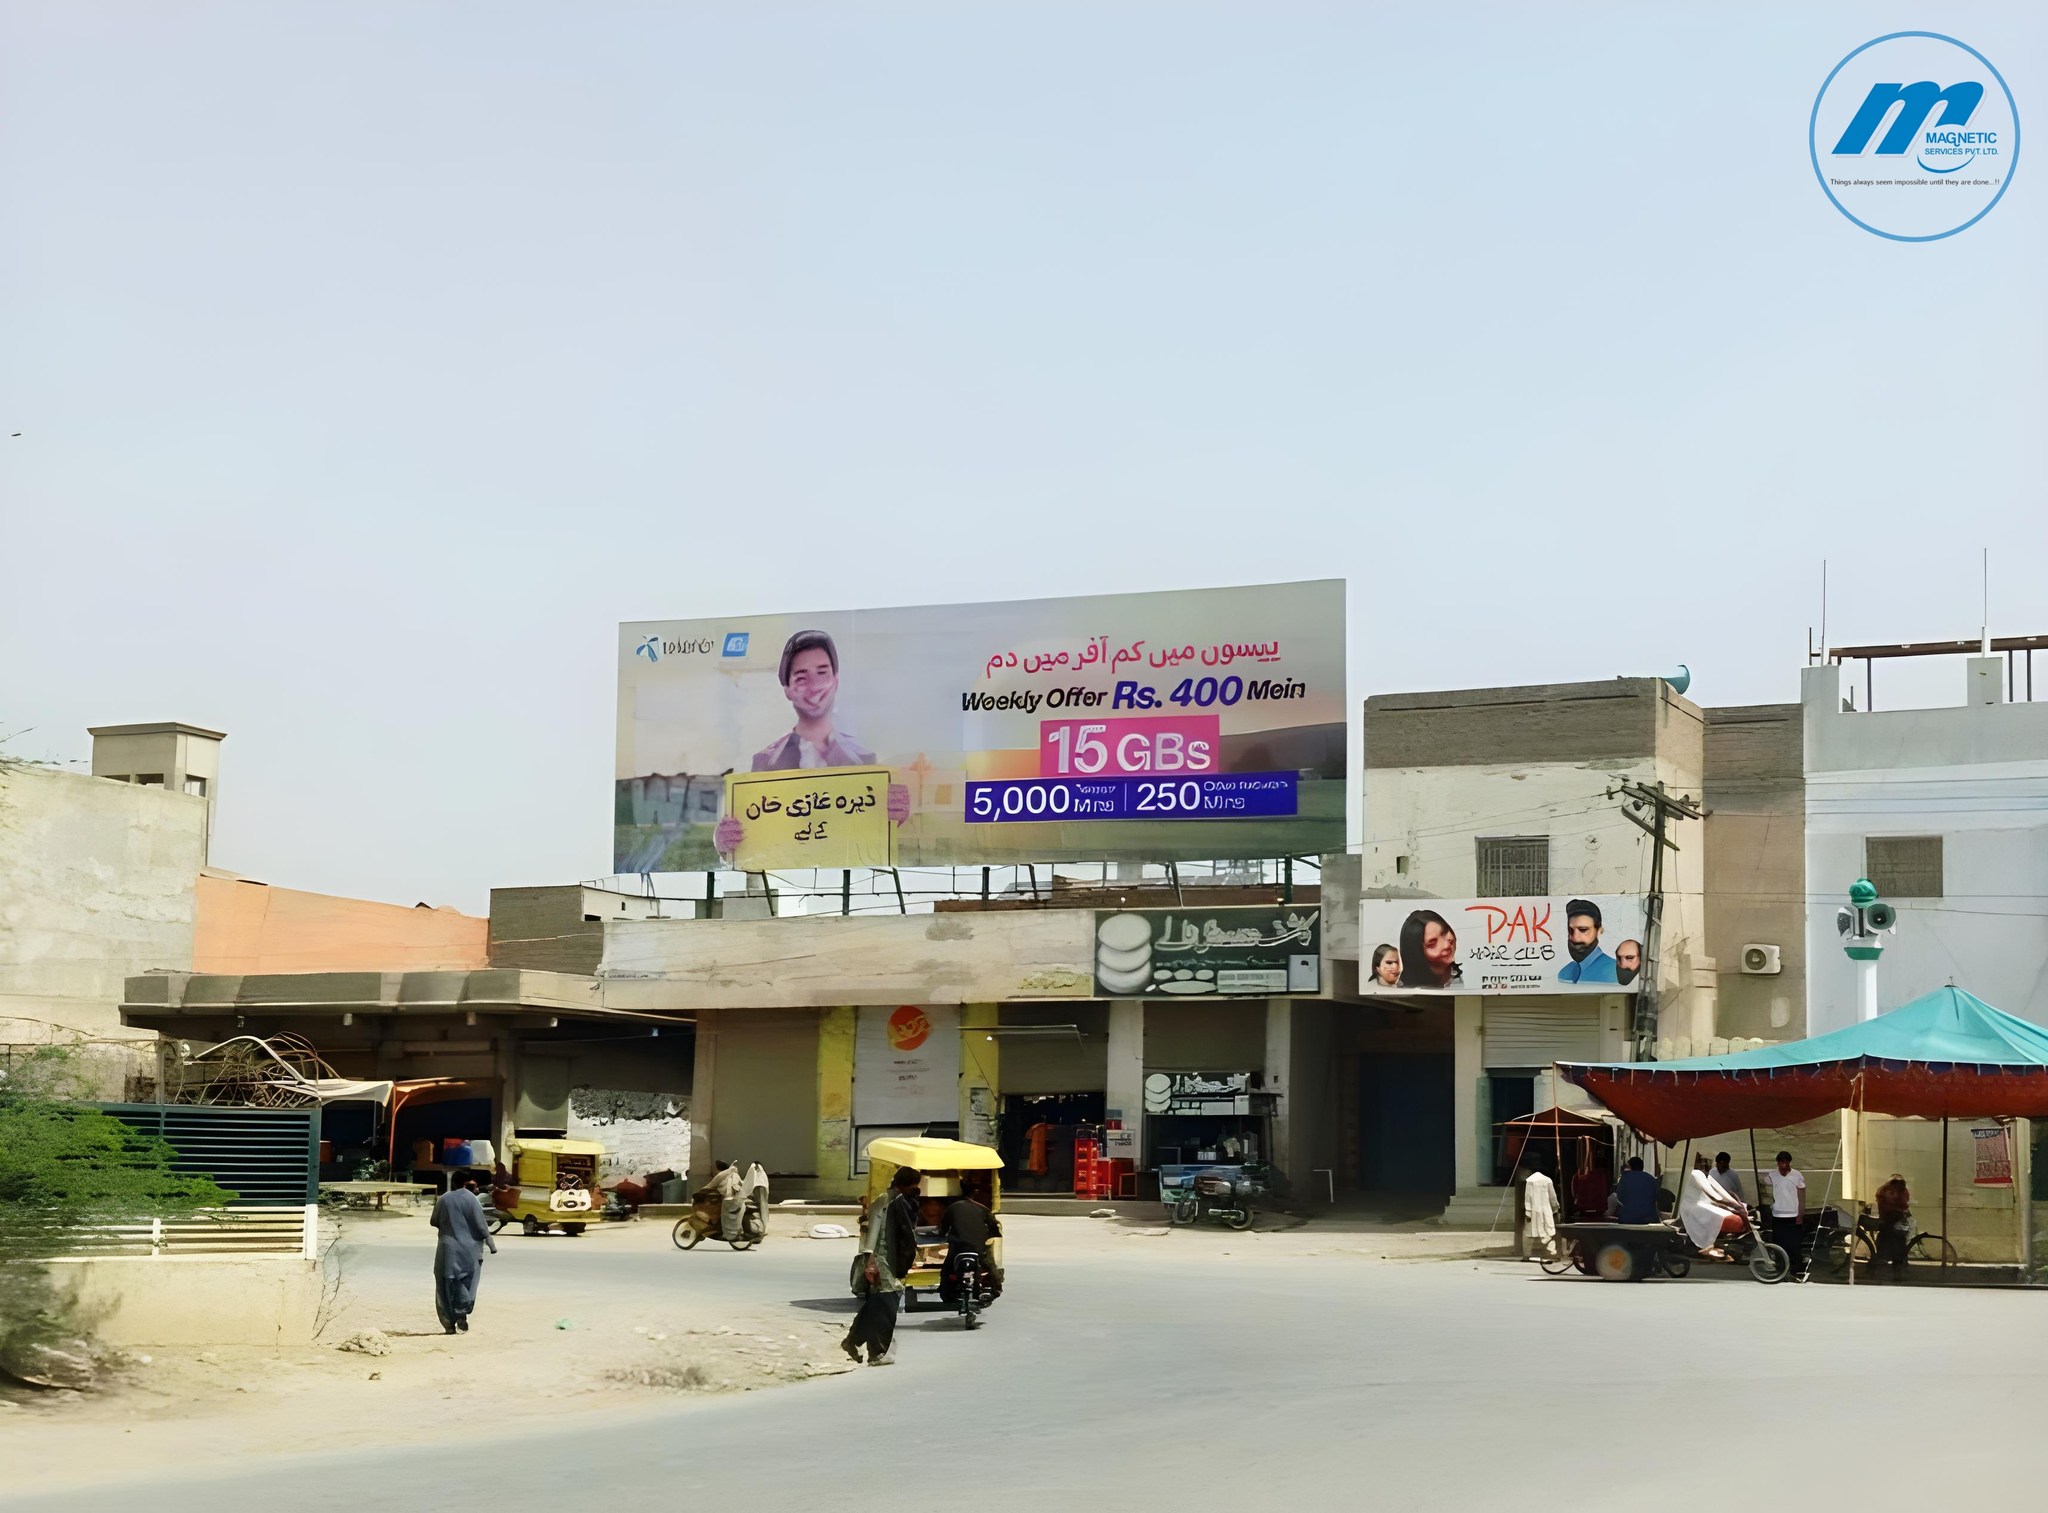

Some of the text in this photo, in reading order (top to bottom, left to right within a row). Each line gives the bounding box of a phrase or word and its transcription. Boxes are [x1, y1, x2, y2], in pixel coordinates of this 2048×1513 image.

[986, 652, 1018, 679] دم
[1071, 635, 1109, 671] آفر
[1112, 640, 1146, 674] کم
[1112, 681, 1163, 709] Rs.
[1169, 676, 1243, 707] 400
[1048, 724, 1211, 774] 15 GBs
[973, 784, 1070, 822] 5,000
[1136, 781, 1200, 811] 250
[1464, 902, 1553, 944] PAK
